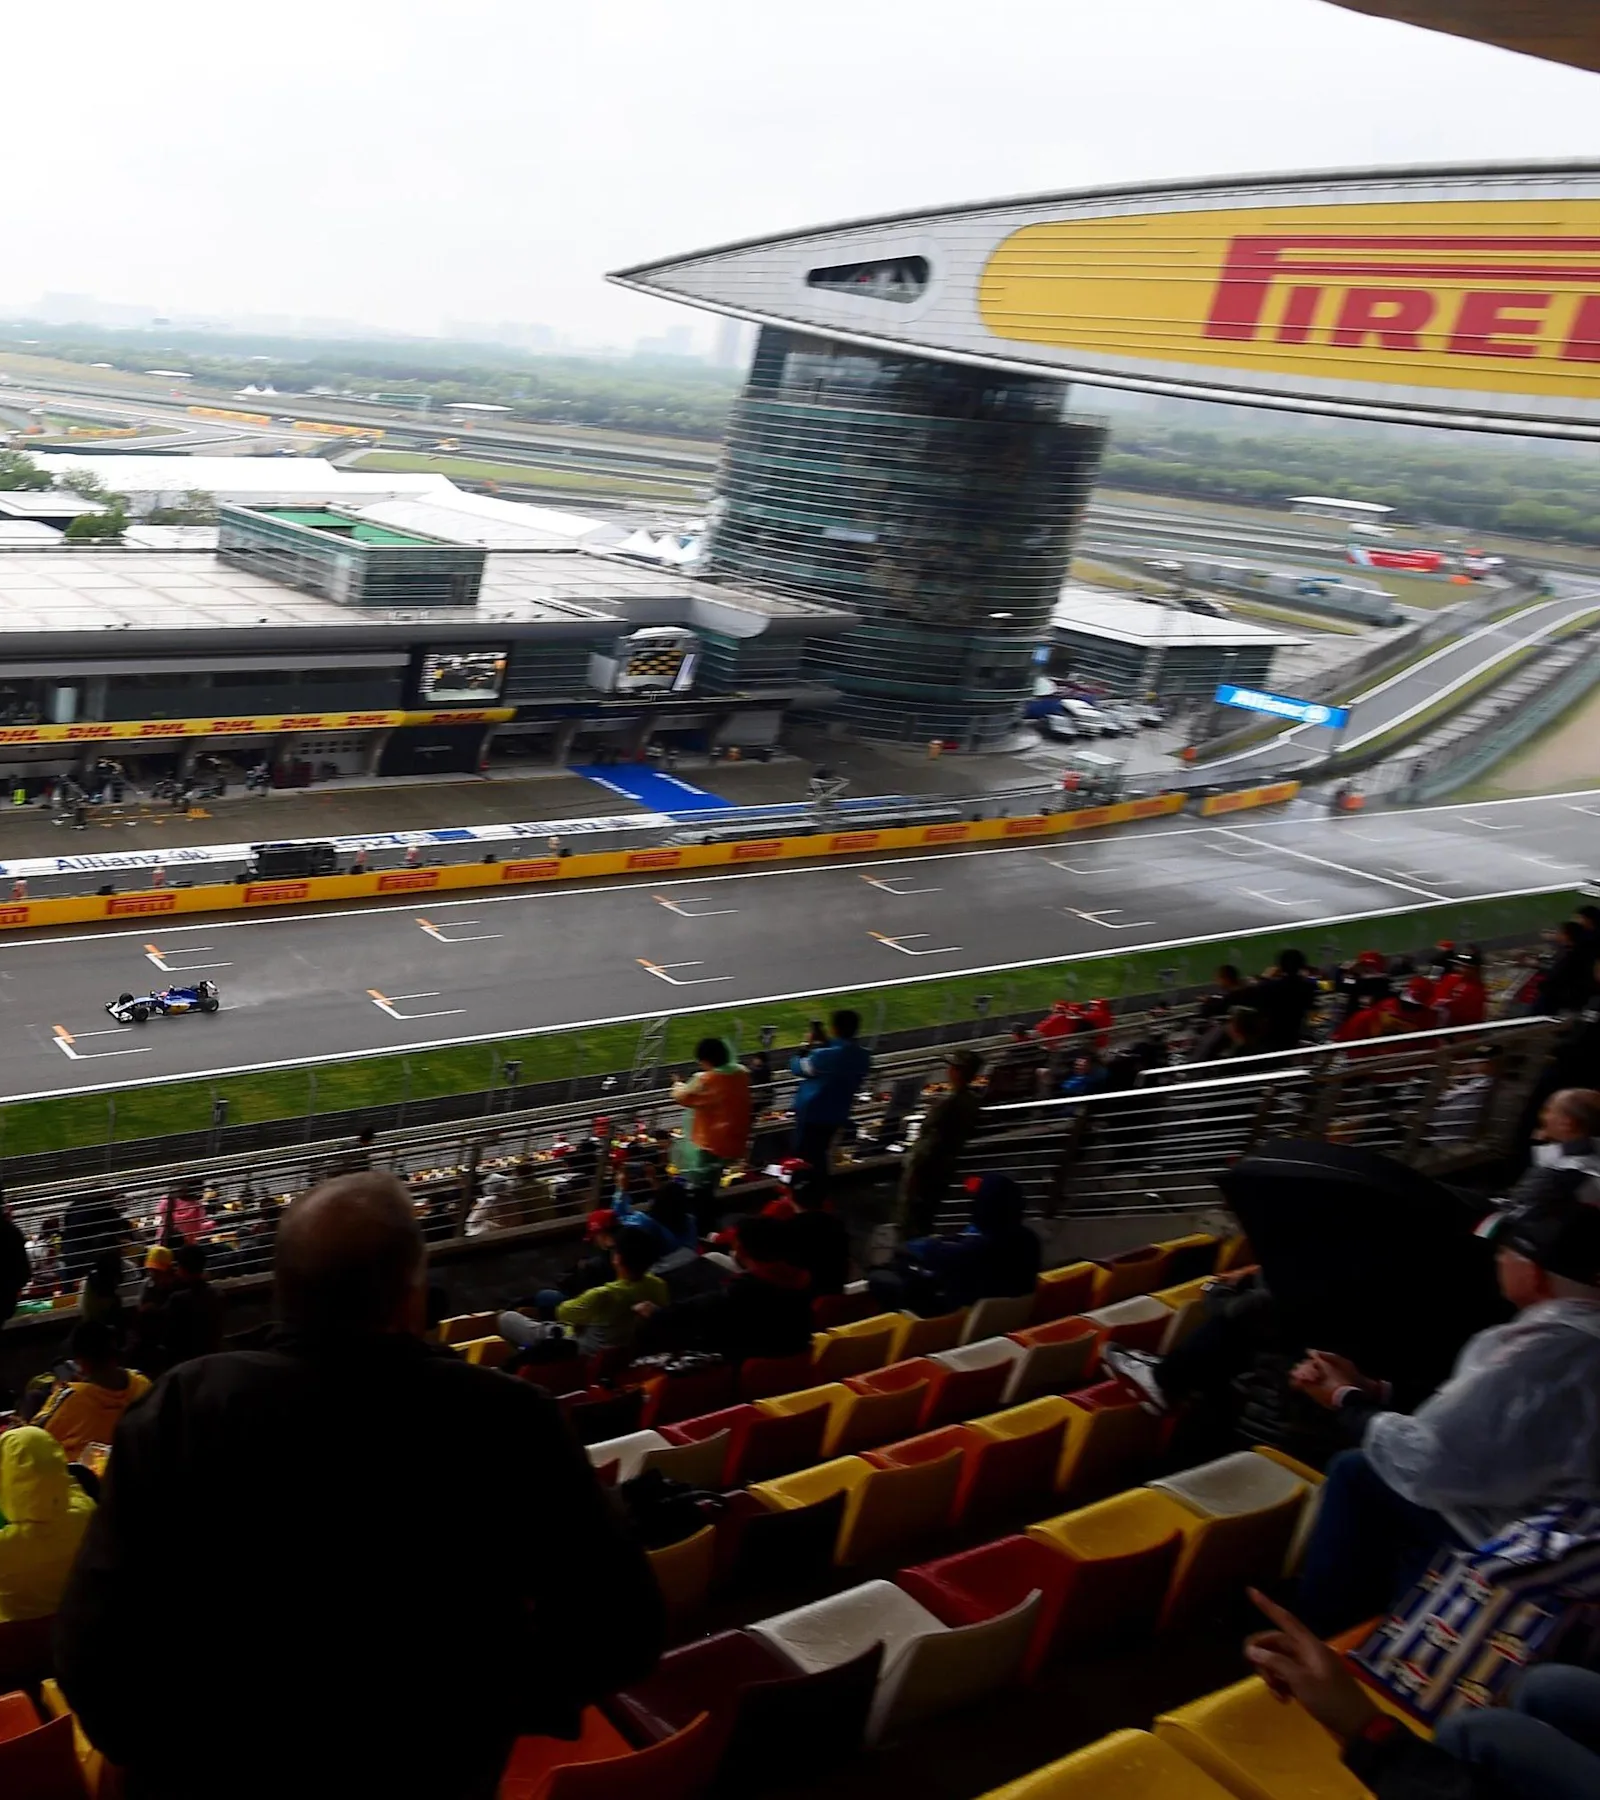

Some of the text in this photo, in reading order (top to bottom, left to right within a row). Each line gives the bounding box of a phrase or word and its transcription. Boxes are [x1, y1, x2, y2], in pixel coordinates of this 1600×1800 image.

[66, 726, 114, 739] DHL
[140, 723, 186, 735] DHL
[212, 720, 256, 732] DHL
[56, 853, 167, 872] Allianz
[105, 894, 176, 916] PIRELLI
